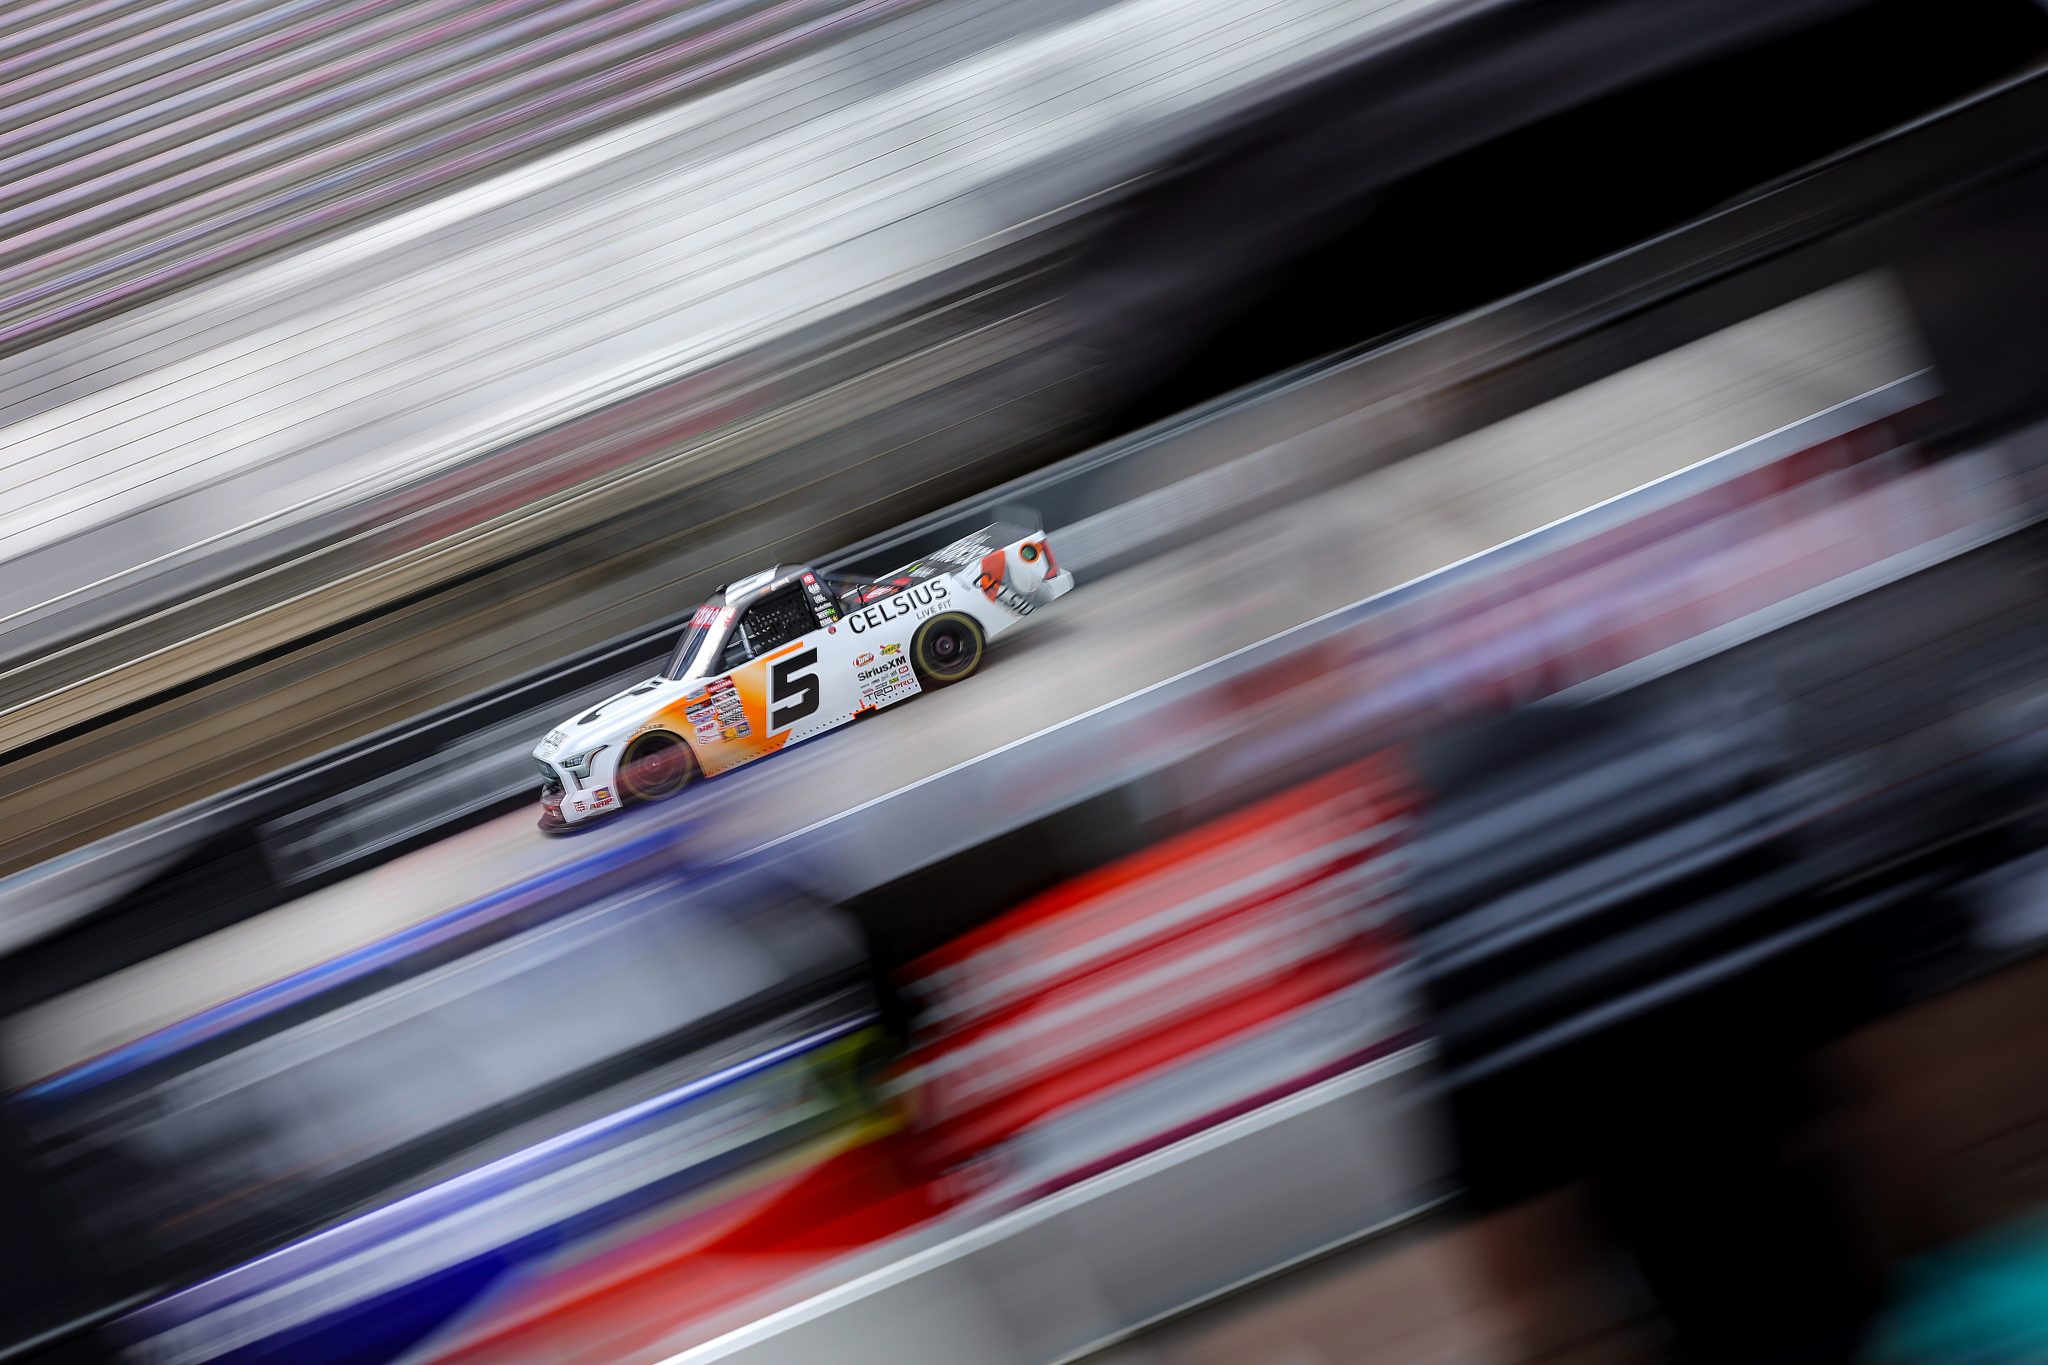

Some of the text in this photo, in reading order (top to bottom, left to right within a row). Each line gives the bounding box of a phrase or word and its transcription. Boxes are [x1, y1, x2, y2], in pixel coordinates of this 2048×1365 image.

[848, 580, 947, 634] CELSIUS
[916, 599, 953, 620] LIVE FIT
[857, 655, 907, 682] SiriusXM
[770, 648, 820, 730] 5
[864, 685, 894, 701] TRD
[893, 678, 914, 691] PRO
